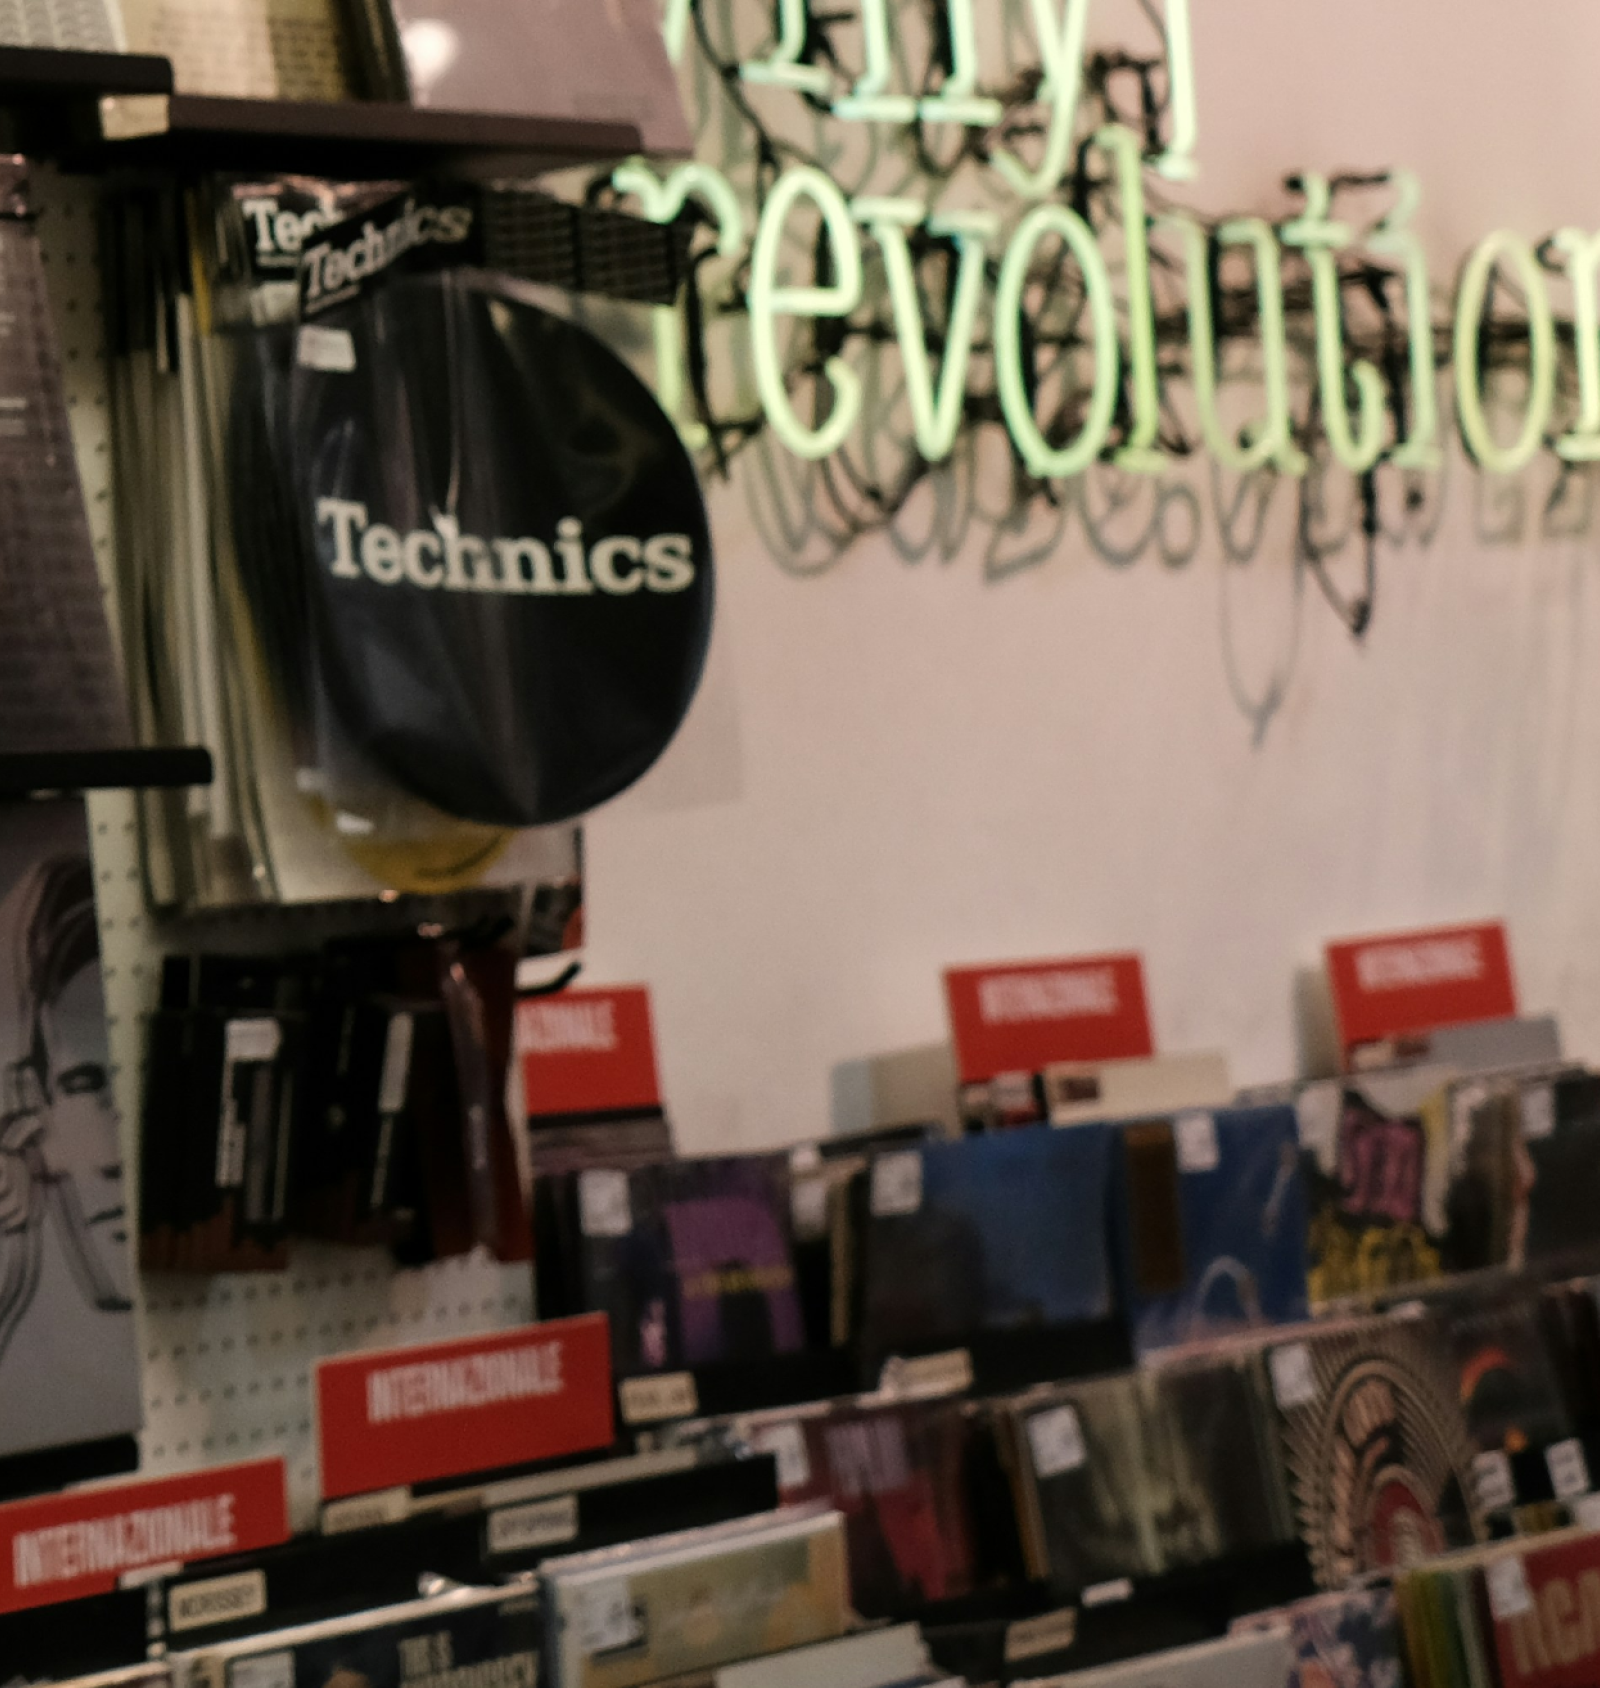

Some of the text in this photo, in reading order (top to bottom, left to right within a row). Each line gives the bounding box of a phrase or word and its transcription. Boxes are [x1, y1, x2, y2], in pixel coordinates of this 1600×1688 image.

[300, 196, 474, 303] Technics
[314, 496, 696, 597] Technics
[365, 1338, 564, 1426] INTERNAZIONALE
[11, 1494, 237, 1590] INTERNAZIONALE
